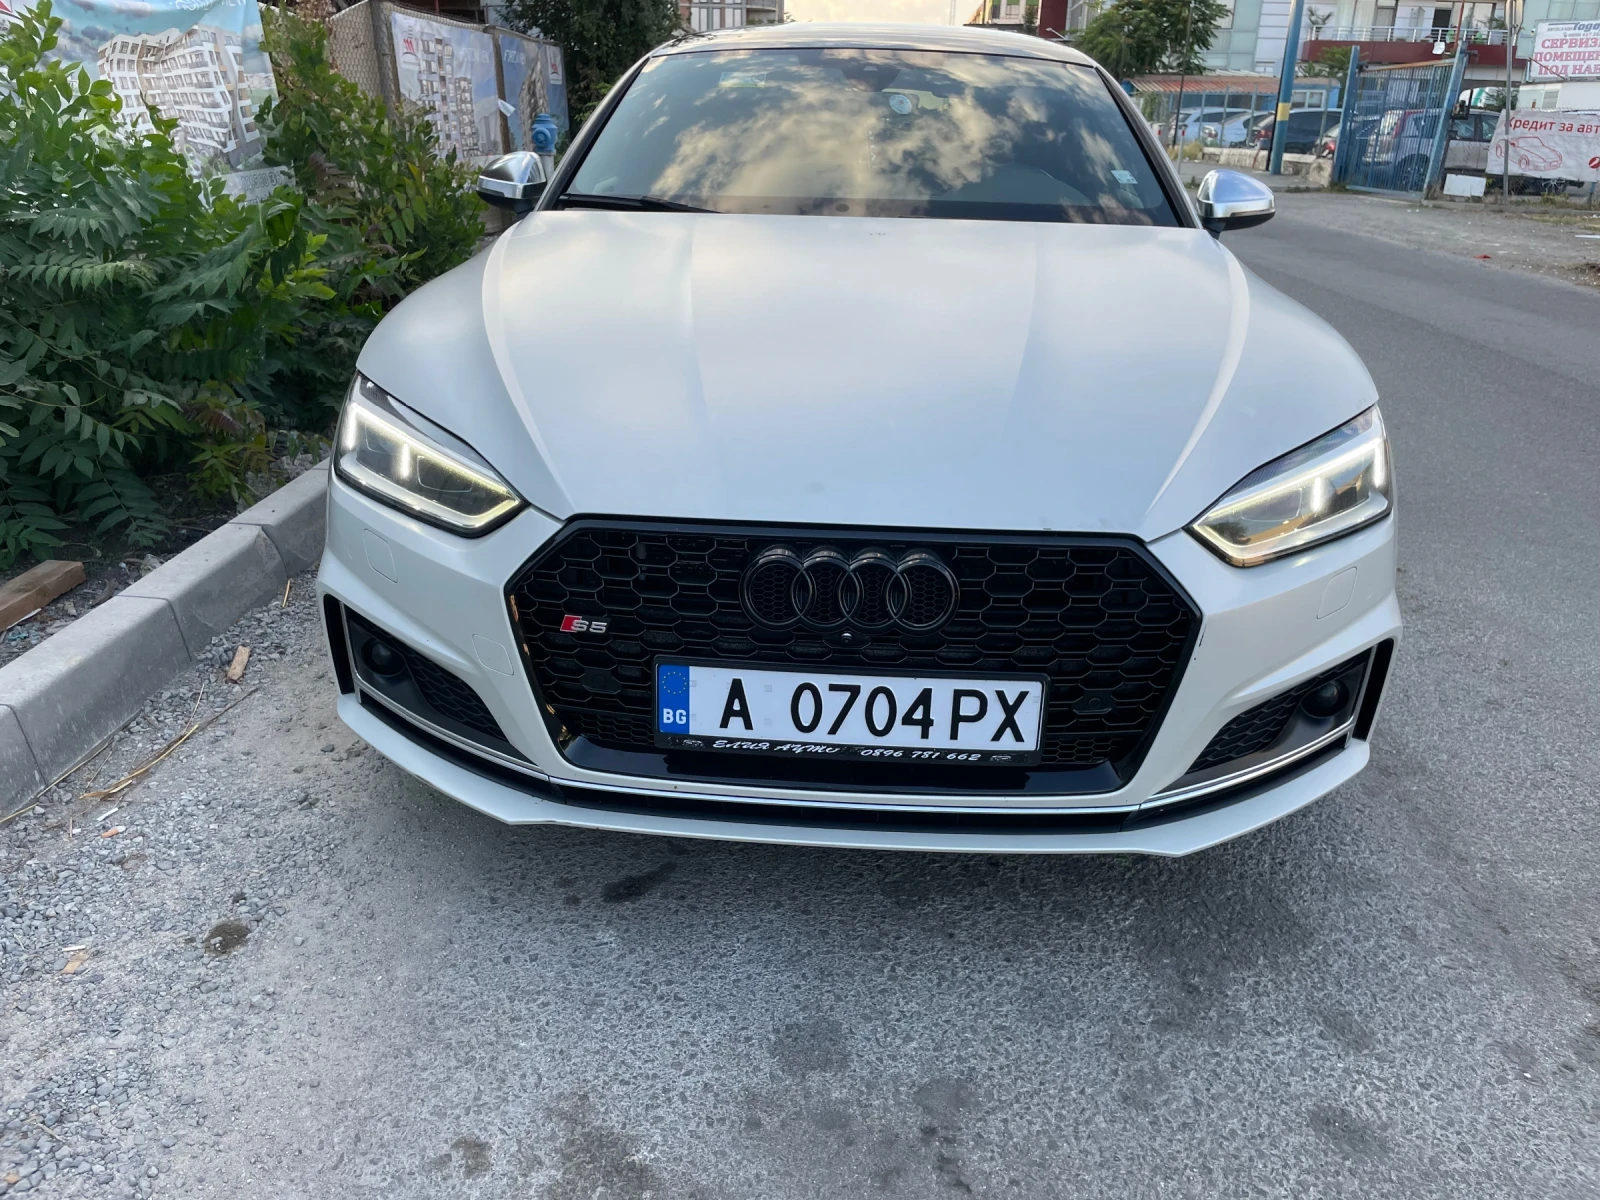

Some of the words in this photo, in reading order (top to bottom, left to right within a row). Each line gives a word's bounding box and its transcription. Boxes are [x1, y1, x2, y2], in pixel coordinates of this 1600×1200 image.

[1541, 37, 1600, 49] СЕРВИЗ
[1538, 65, 1569, 77] ПОД
[1558, 122, 1574, 133] за
[571, 619, 608, 633] S5
[663, 708, 687, 725] BG
[860, 748, 903, 758] 0896
[911, 750, 941, 759] 781
[946, 752, 982, 761] 662
